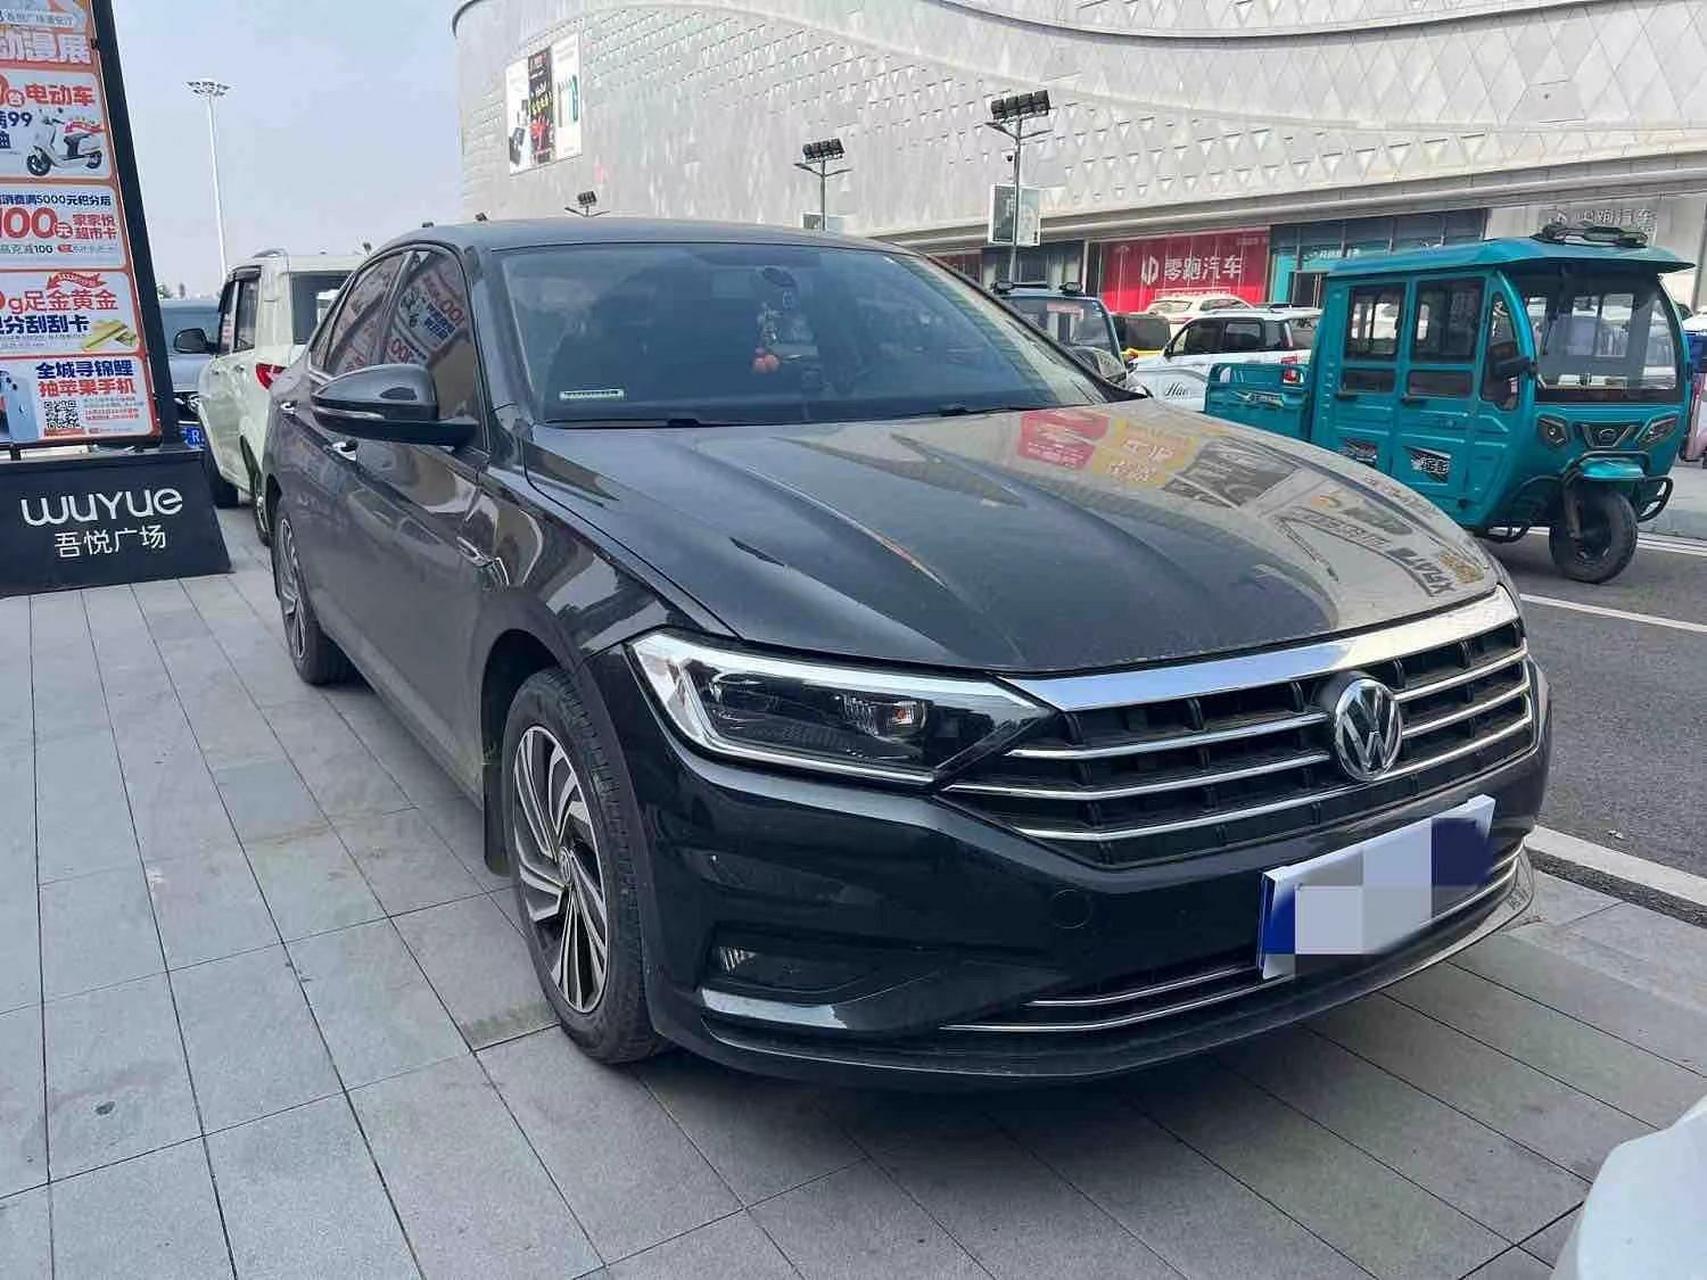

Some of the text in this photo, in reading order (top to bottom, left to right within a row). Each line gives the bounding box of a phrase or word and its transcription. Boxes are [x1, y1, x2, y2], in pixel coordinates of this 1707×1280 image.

[1164, 254, 1243, 282] 零跑汽车
[0, 289, 118, 315] g足金黄金
[0, 314, 89, 335] 分刮刮卡
[36, 360, 134, 380] 全城寻锦鲤
[54, 524, 166, 558] 吾悦广场
